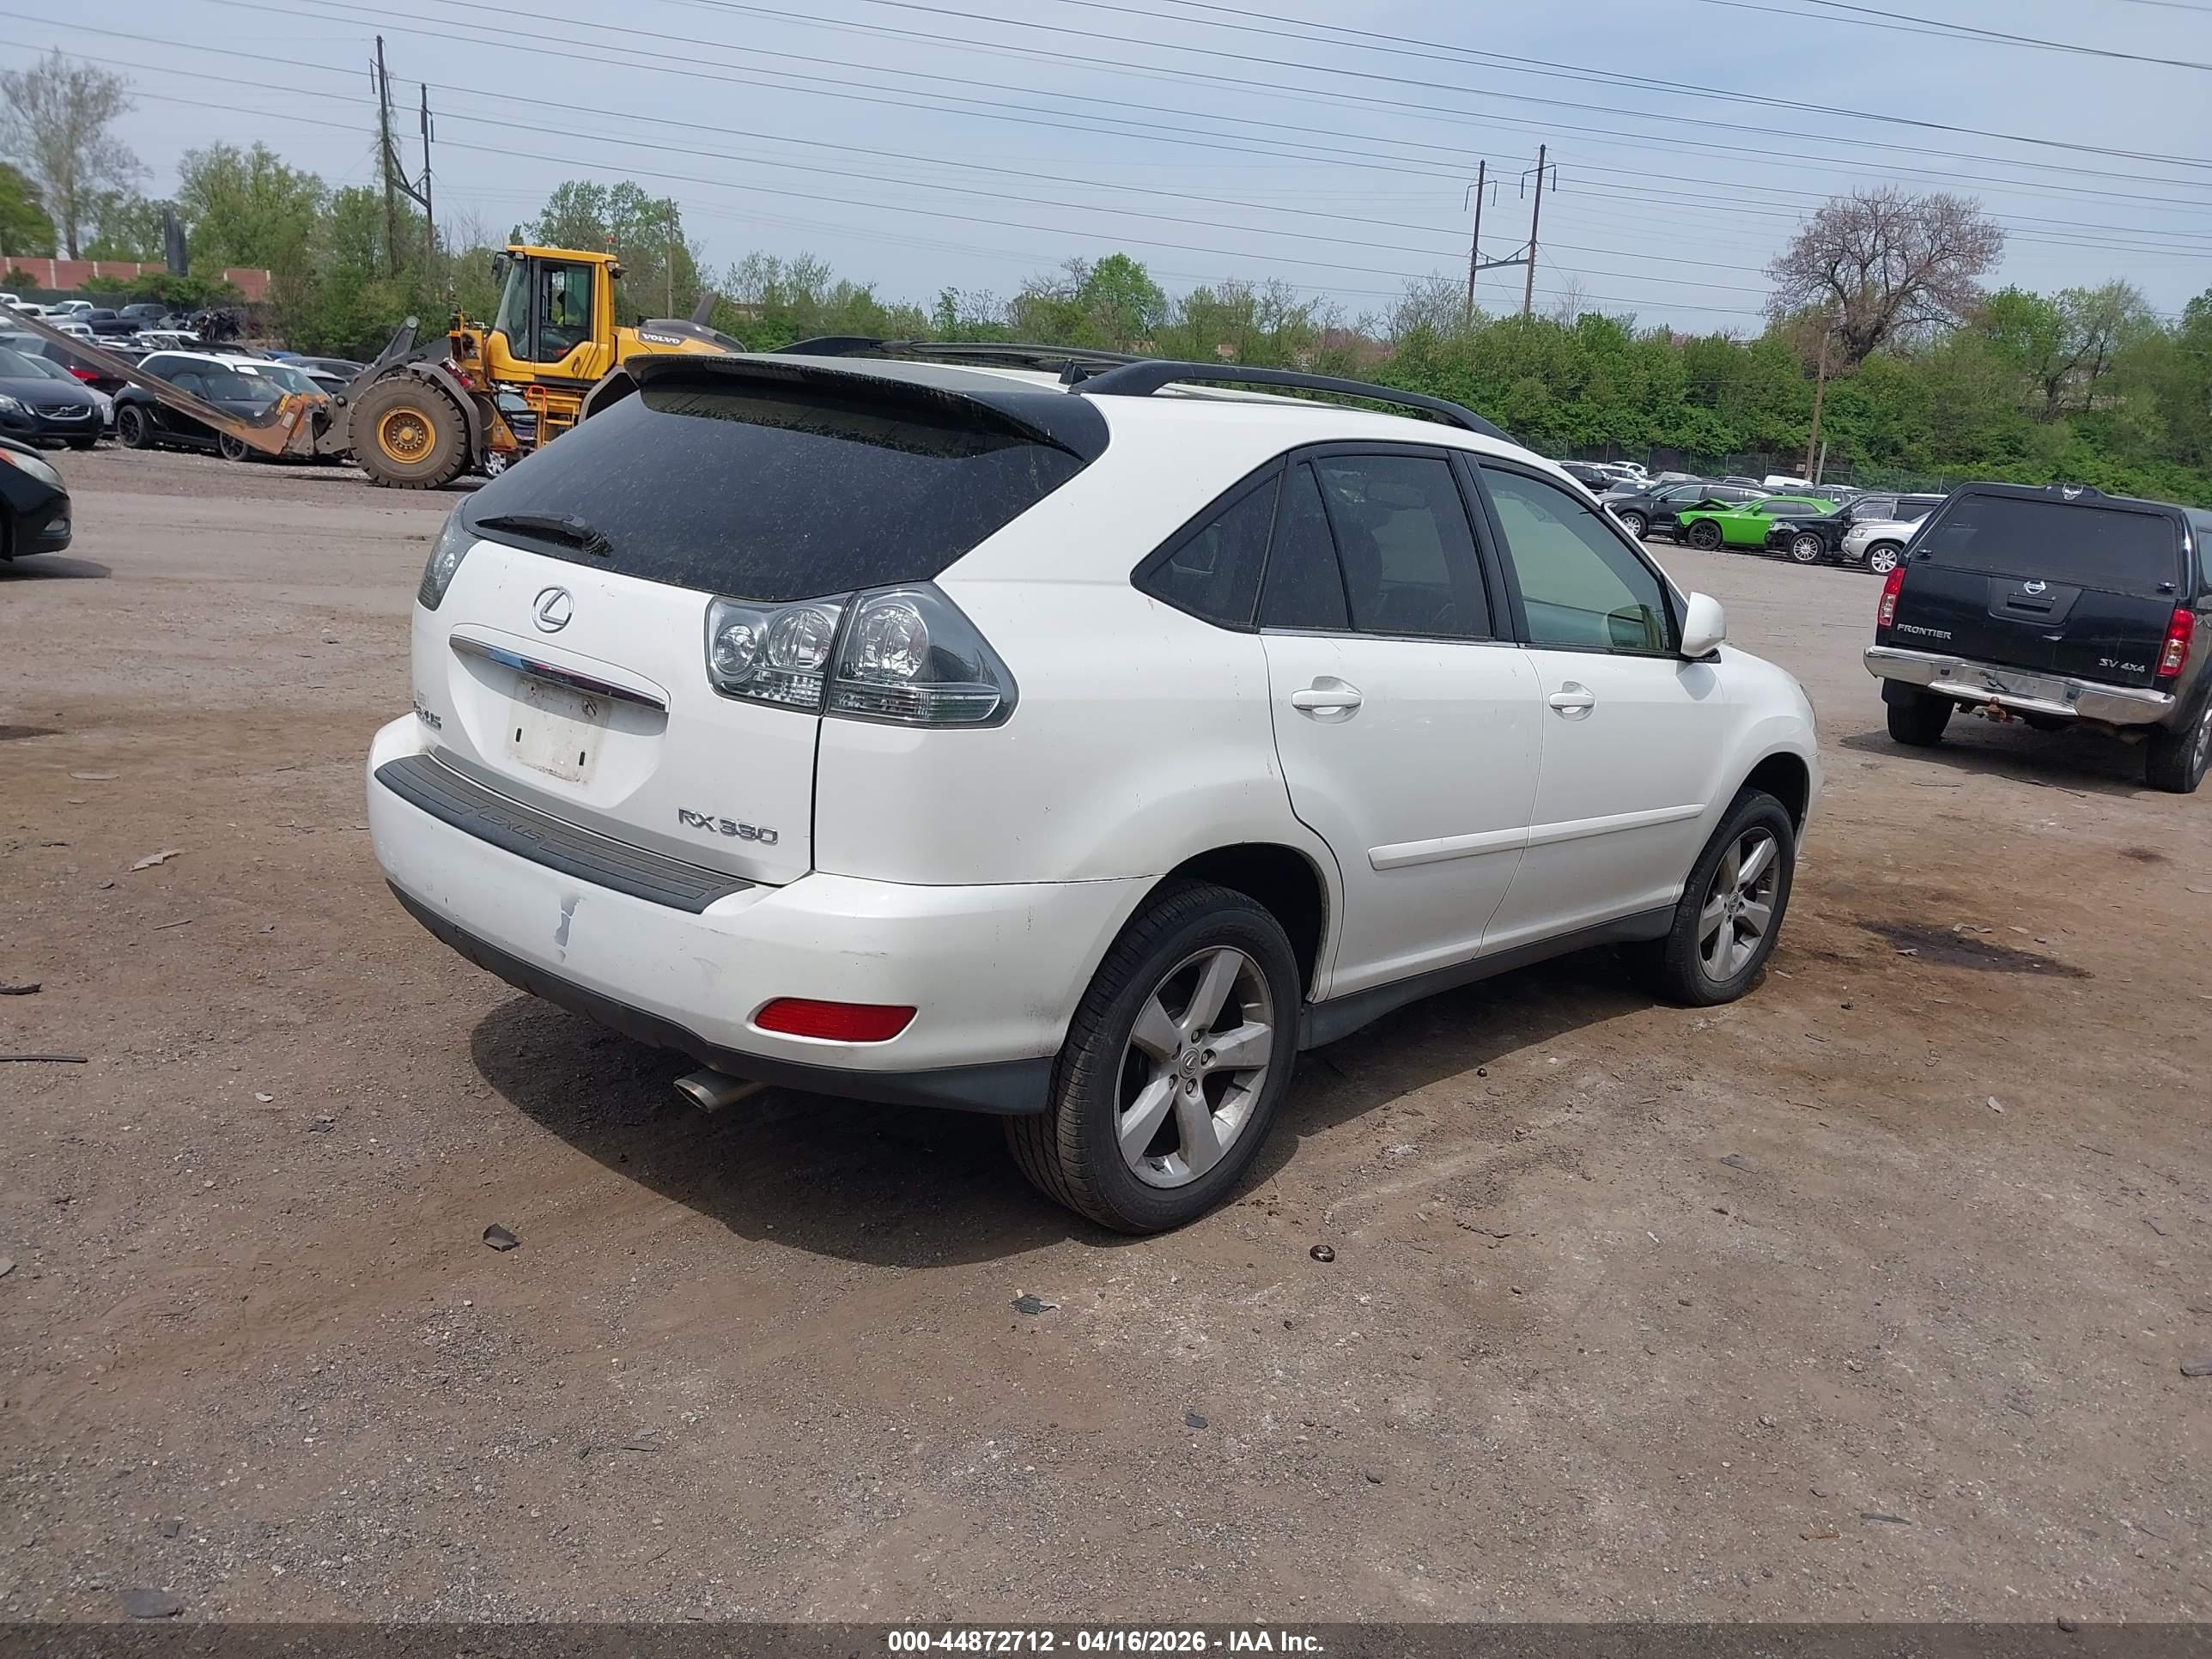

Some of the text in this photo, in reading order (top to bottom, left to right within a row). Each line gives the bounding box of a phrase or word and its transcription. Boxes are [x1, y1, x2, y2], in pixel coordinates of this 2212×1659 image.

[641, 332, 680, 344] VOLVO
[1897, 623, 1952, 640] FRONTIER
[2099, 658, 2119, 668] SV
[678, 807, 778, 846] RX 330
